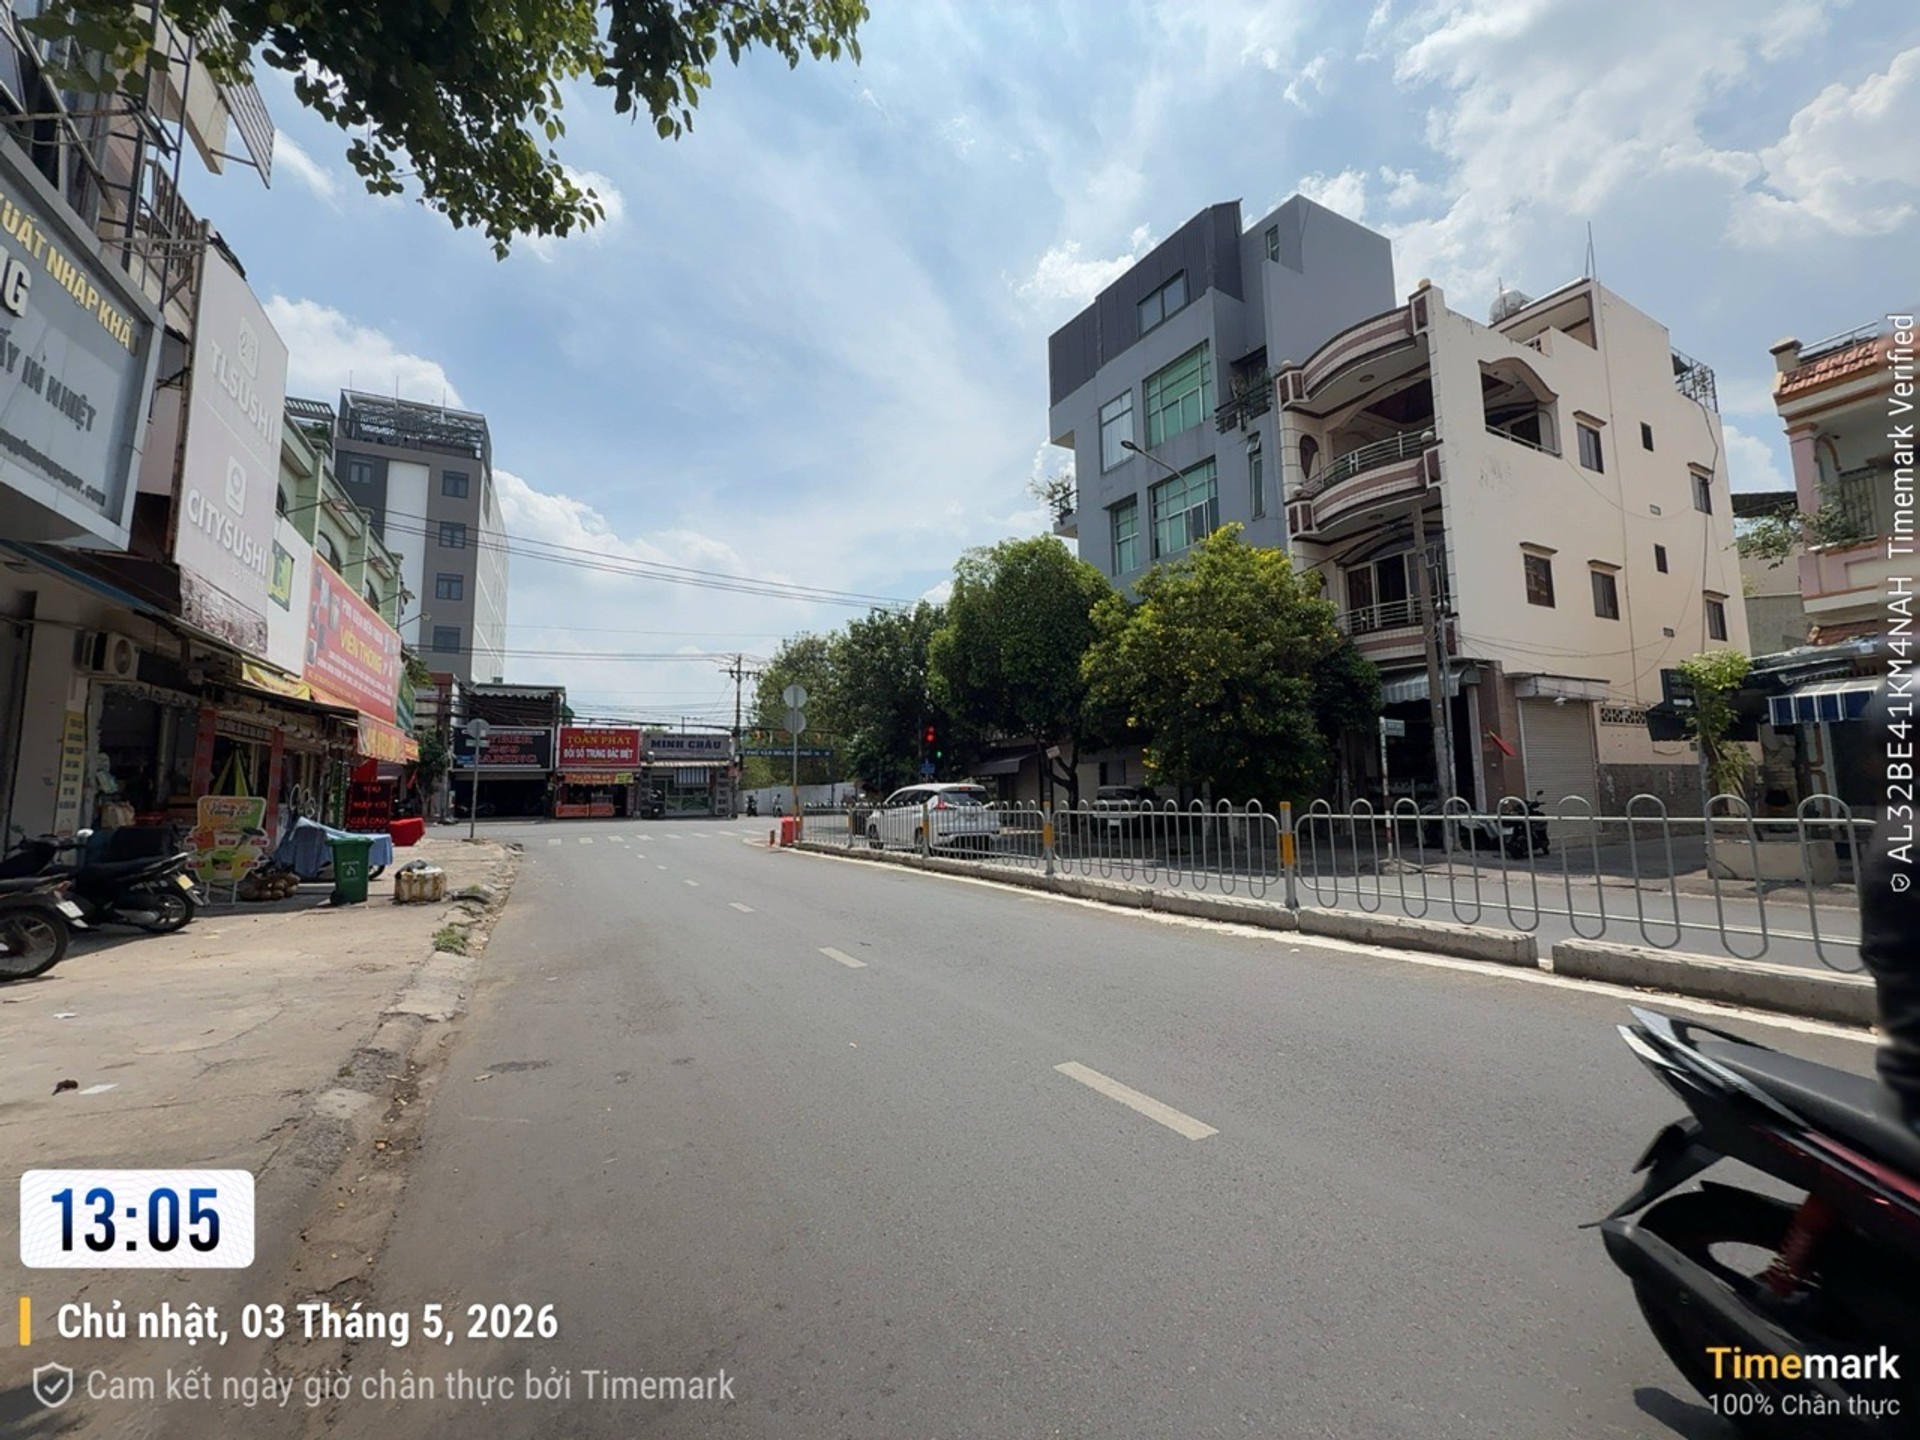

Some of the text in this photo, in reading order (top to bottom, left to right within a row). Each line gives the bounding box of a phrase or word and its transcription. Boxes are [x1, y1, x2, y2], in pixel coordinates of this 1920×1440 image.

[0, 191, 46, 260] UẤT
[211, 338, 275, 446] TLSUSHI
[187, 489, 267, 575] CITYSUSHI
[651, 738, 722, 749] MINH CHÂU
